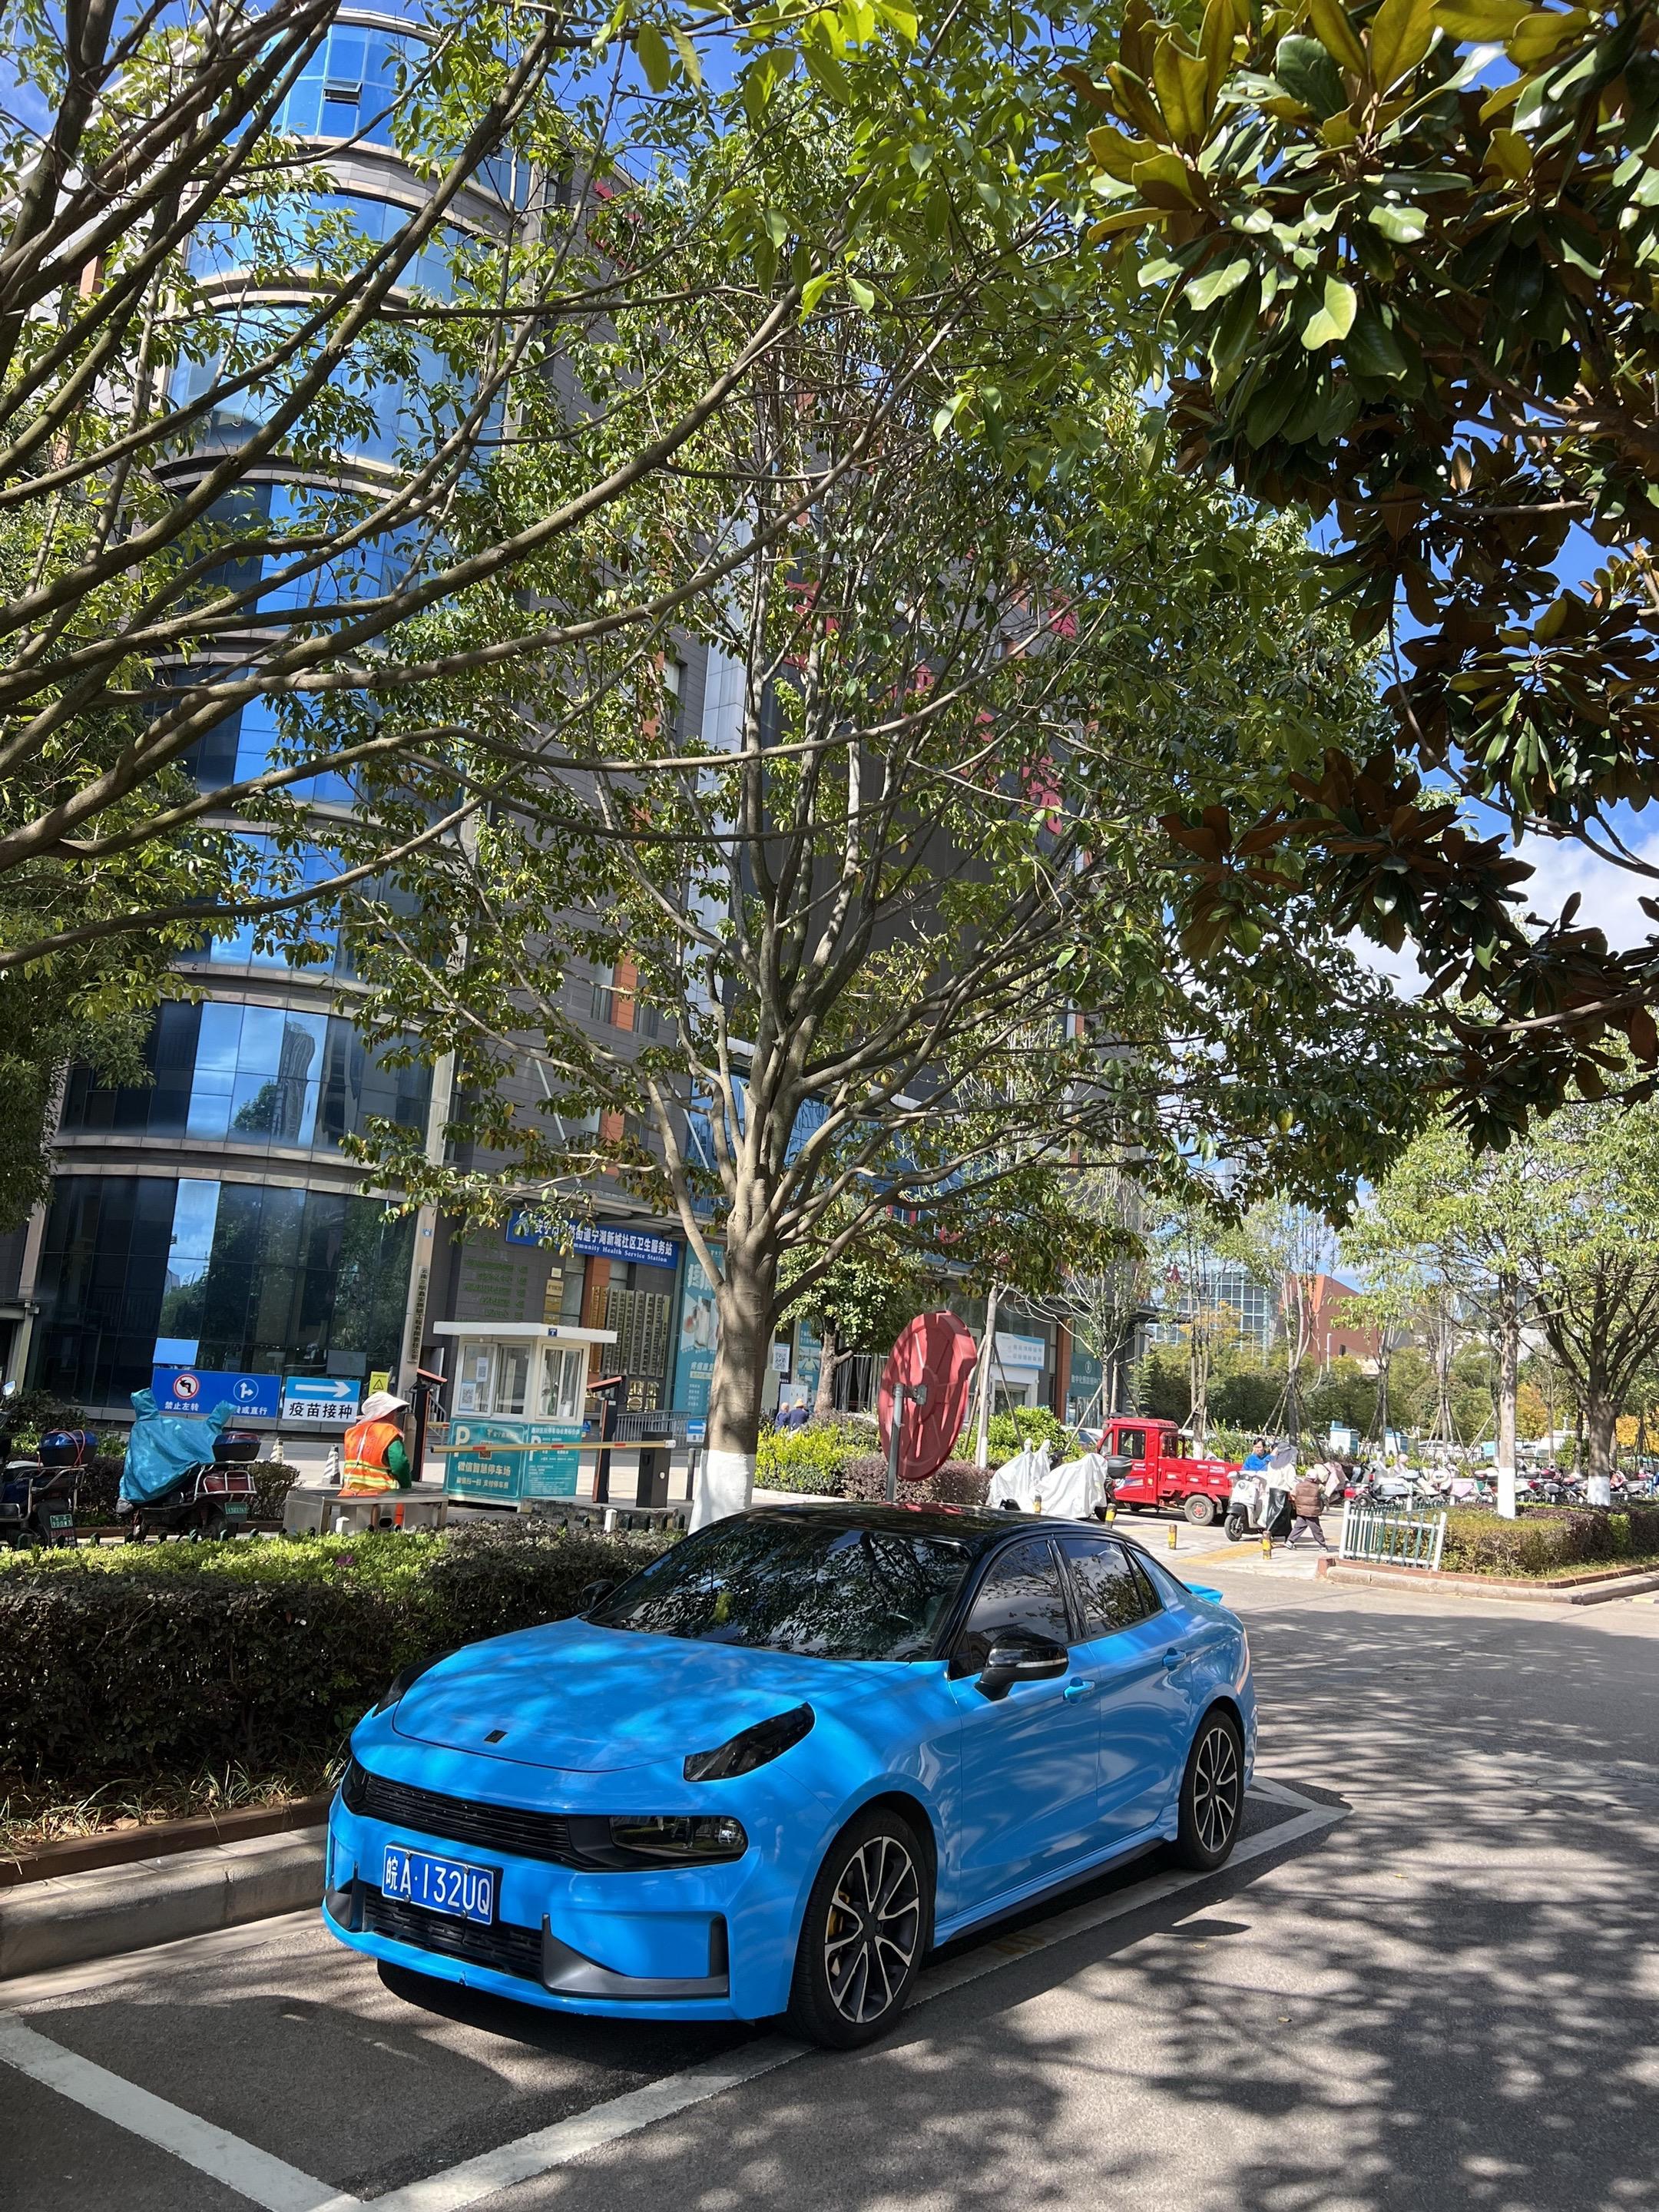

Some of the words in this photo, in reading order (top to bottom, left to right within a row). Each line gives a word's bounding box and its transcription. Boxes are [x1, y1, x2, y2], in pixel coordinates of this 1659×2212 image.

[535, 1218, 673, 1256] 安宁市然街道宁湖新城社区卫生服务站
[602, 1246, 622, 1256] Health
[624, 1250, 644, 1260] Service
[647, 1253, 667, 1263] Station
[164, 1401, 199, 1412] 禁止左转
[289, 1402, 352, 1419] 疫苗接种
[454, 1426, 470, 1457] P
[458, 1461, 512, 1477] 微信智慧停车场
